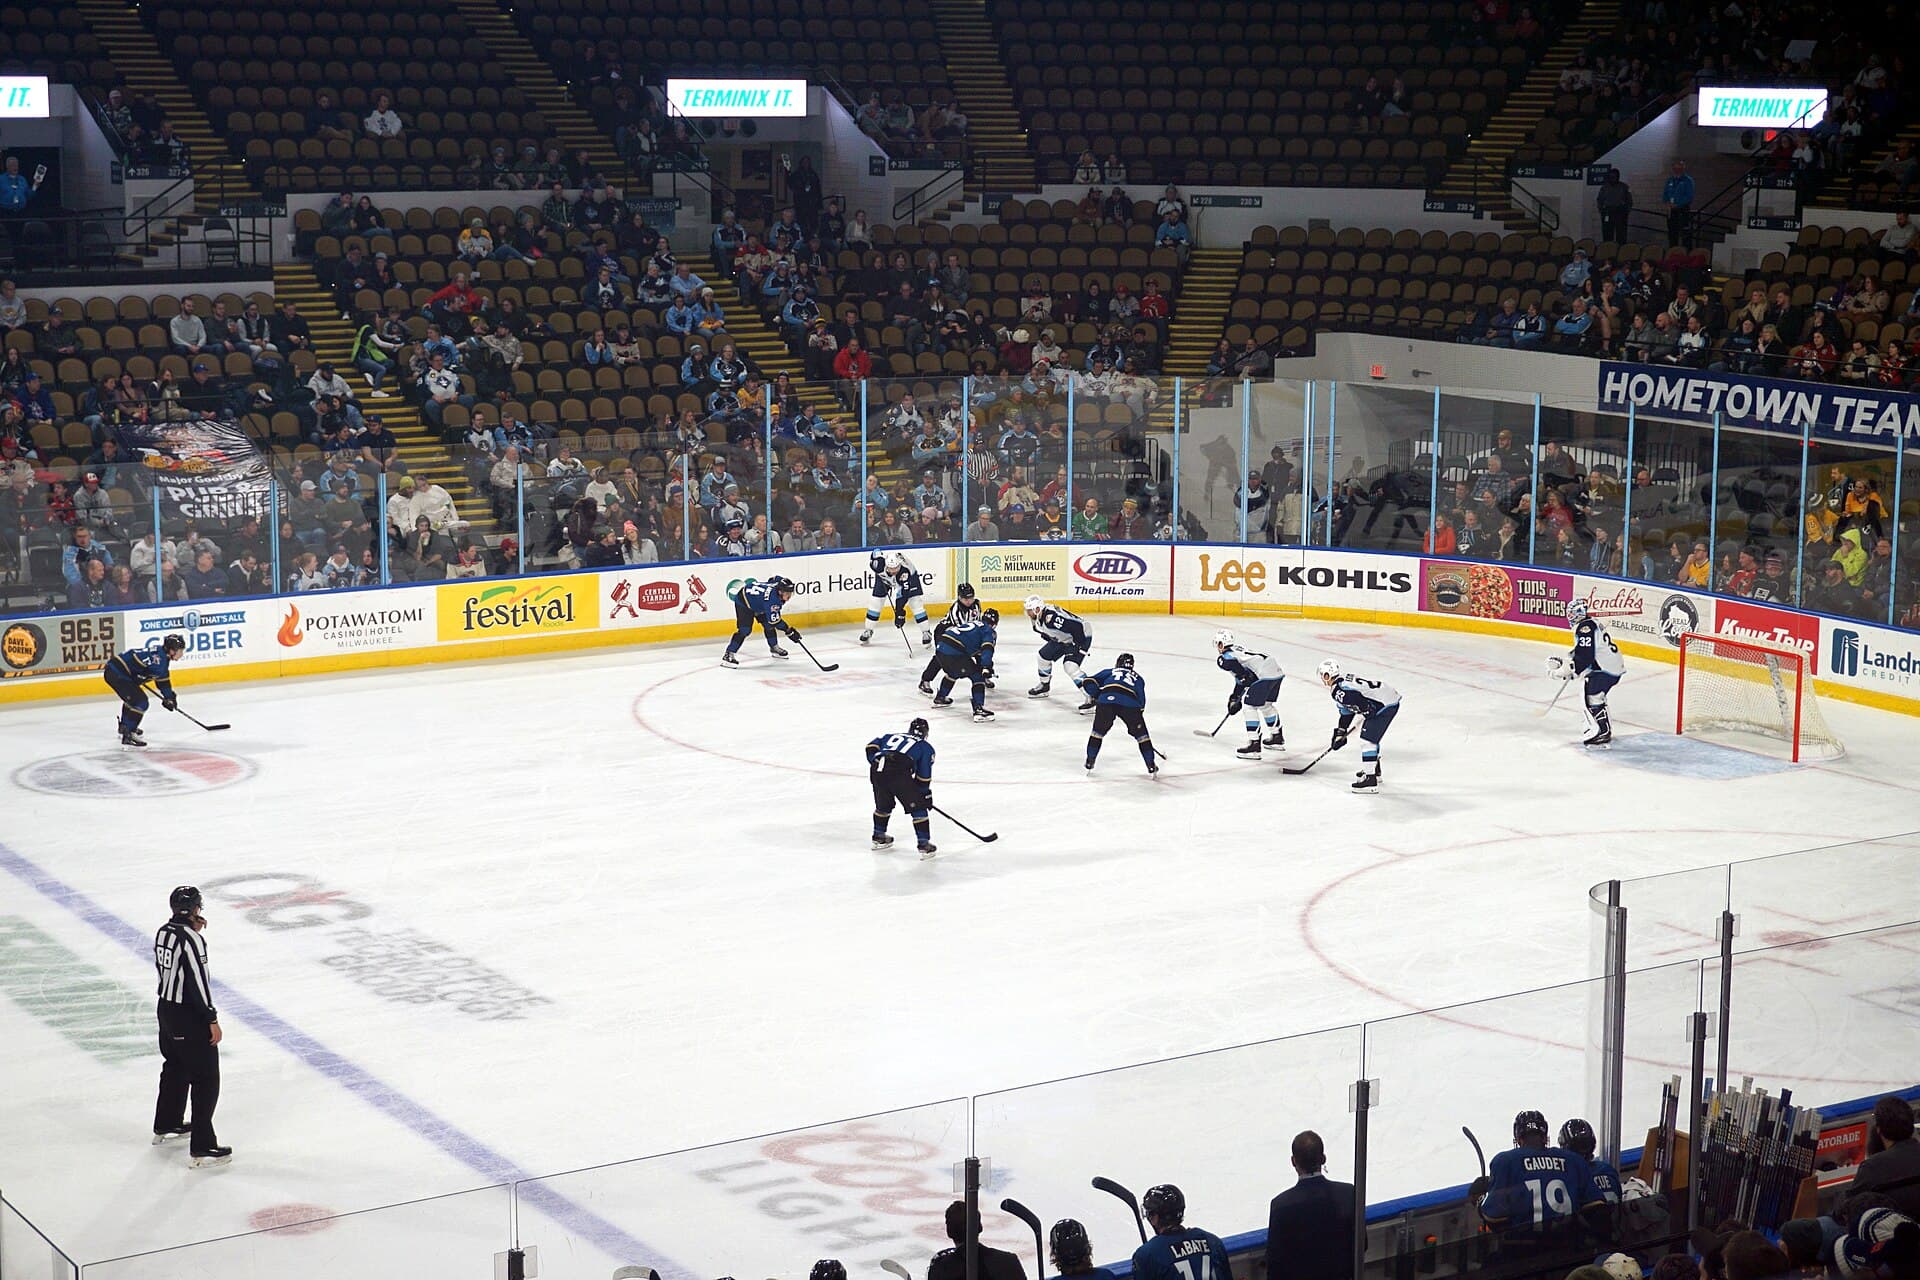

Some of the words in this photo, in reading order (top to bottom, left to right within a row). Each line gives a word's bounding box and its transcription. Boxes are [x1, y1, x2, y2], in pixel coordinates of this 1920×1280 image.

[8, 87, 31, 107] IT.
[683, 89, 770, 108] TERMINIX
[774, 89, 793, 108] IT.
[1711, 97, 1793, 118] TERMINIX
[1795, 99, 1814, 119] IT.
[1603, 371, 1822, 426] HOMETOWN
[159, 475, 192, 486] Major
[1004, 561, 1056, 571] MILWAUKEE
[1087, 557, 1134, 575] AHL
[1199, 554, 1266, 592] Lee
[828, 572, 875, 592] Healt
[1279, 566, 1412, 593] KOHL'S
[1517, 579, 1546, 596] TONS
[1549, 588, 1558, 598] OF
[642, 594, 676, 602] STANDARD
[644, 587, 673, 596] CENTRAL
[1074, 586, 1145, 596] TheAHL.com
[1583, 587, 1644, 609] Sendik's
[462, 592, 575, 631] festival
[1518, 597, 1566, 617] TOPPINGS
[144, 621, 161, 630] ONE
[162, 619, 183, 629] CALL
[201, 613, 227, 625] THAT'S
[228, 611, 243, 622] ALL
[306, 608, 423, 631] POTAWATOMI
[1053, 616, 1065, 630] 42
[1611, 620, 1629, 630] REAL
[1630, 623, 1656, 634] PEOPLE
[60, 616, 115, 643] 96.5
[323, 630, 363, 640] CASINO
[370, 626, 403, 636] HOTEL
[8, 637, 24, 647] DAVE
[8, 645, 33, 656] DORENE
[145, 629, 243, 653] GUBER
[337, 636, 393, 648] MILWAUKEE
[1579, 636, 1592, 647] 32
[62, 642, 115, 664] WKLH
[1862, 667, 1911, 685] CREDIT
[882, 734, 918, 754] 91
[156, 945, 172, 969] 88
[1818, 1131, 1861, 1149] ATORADE
[1524, 1156, 1566, 1172] GAUDET
[1524, 1178, 1573, 1224] 19
